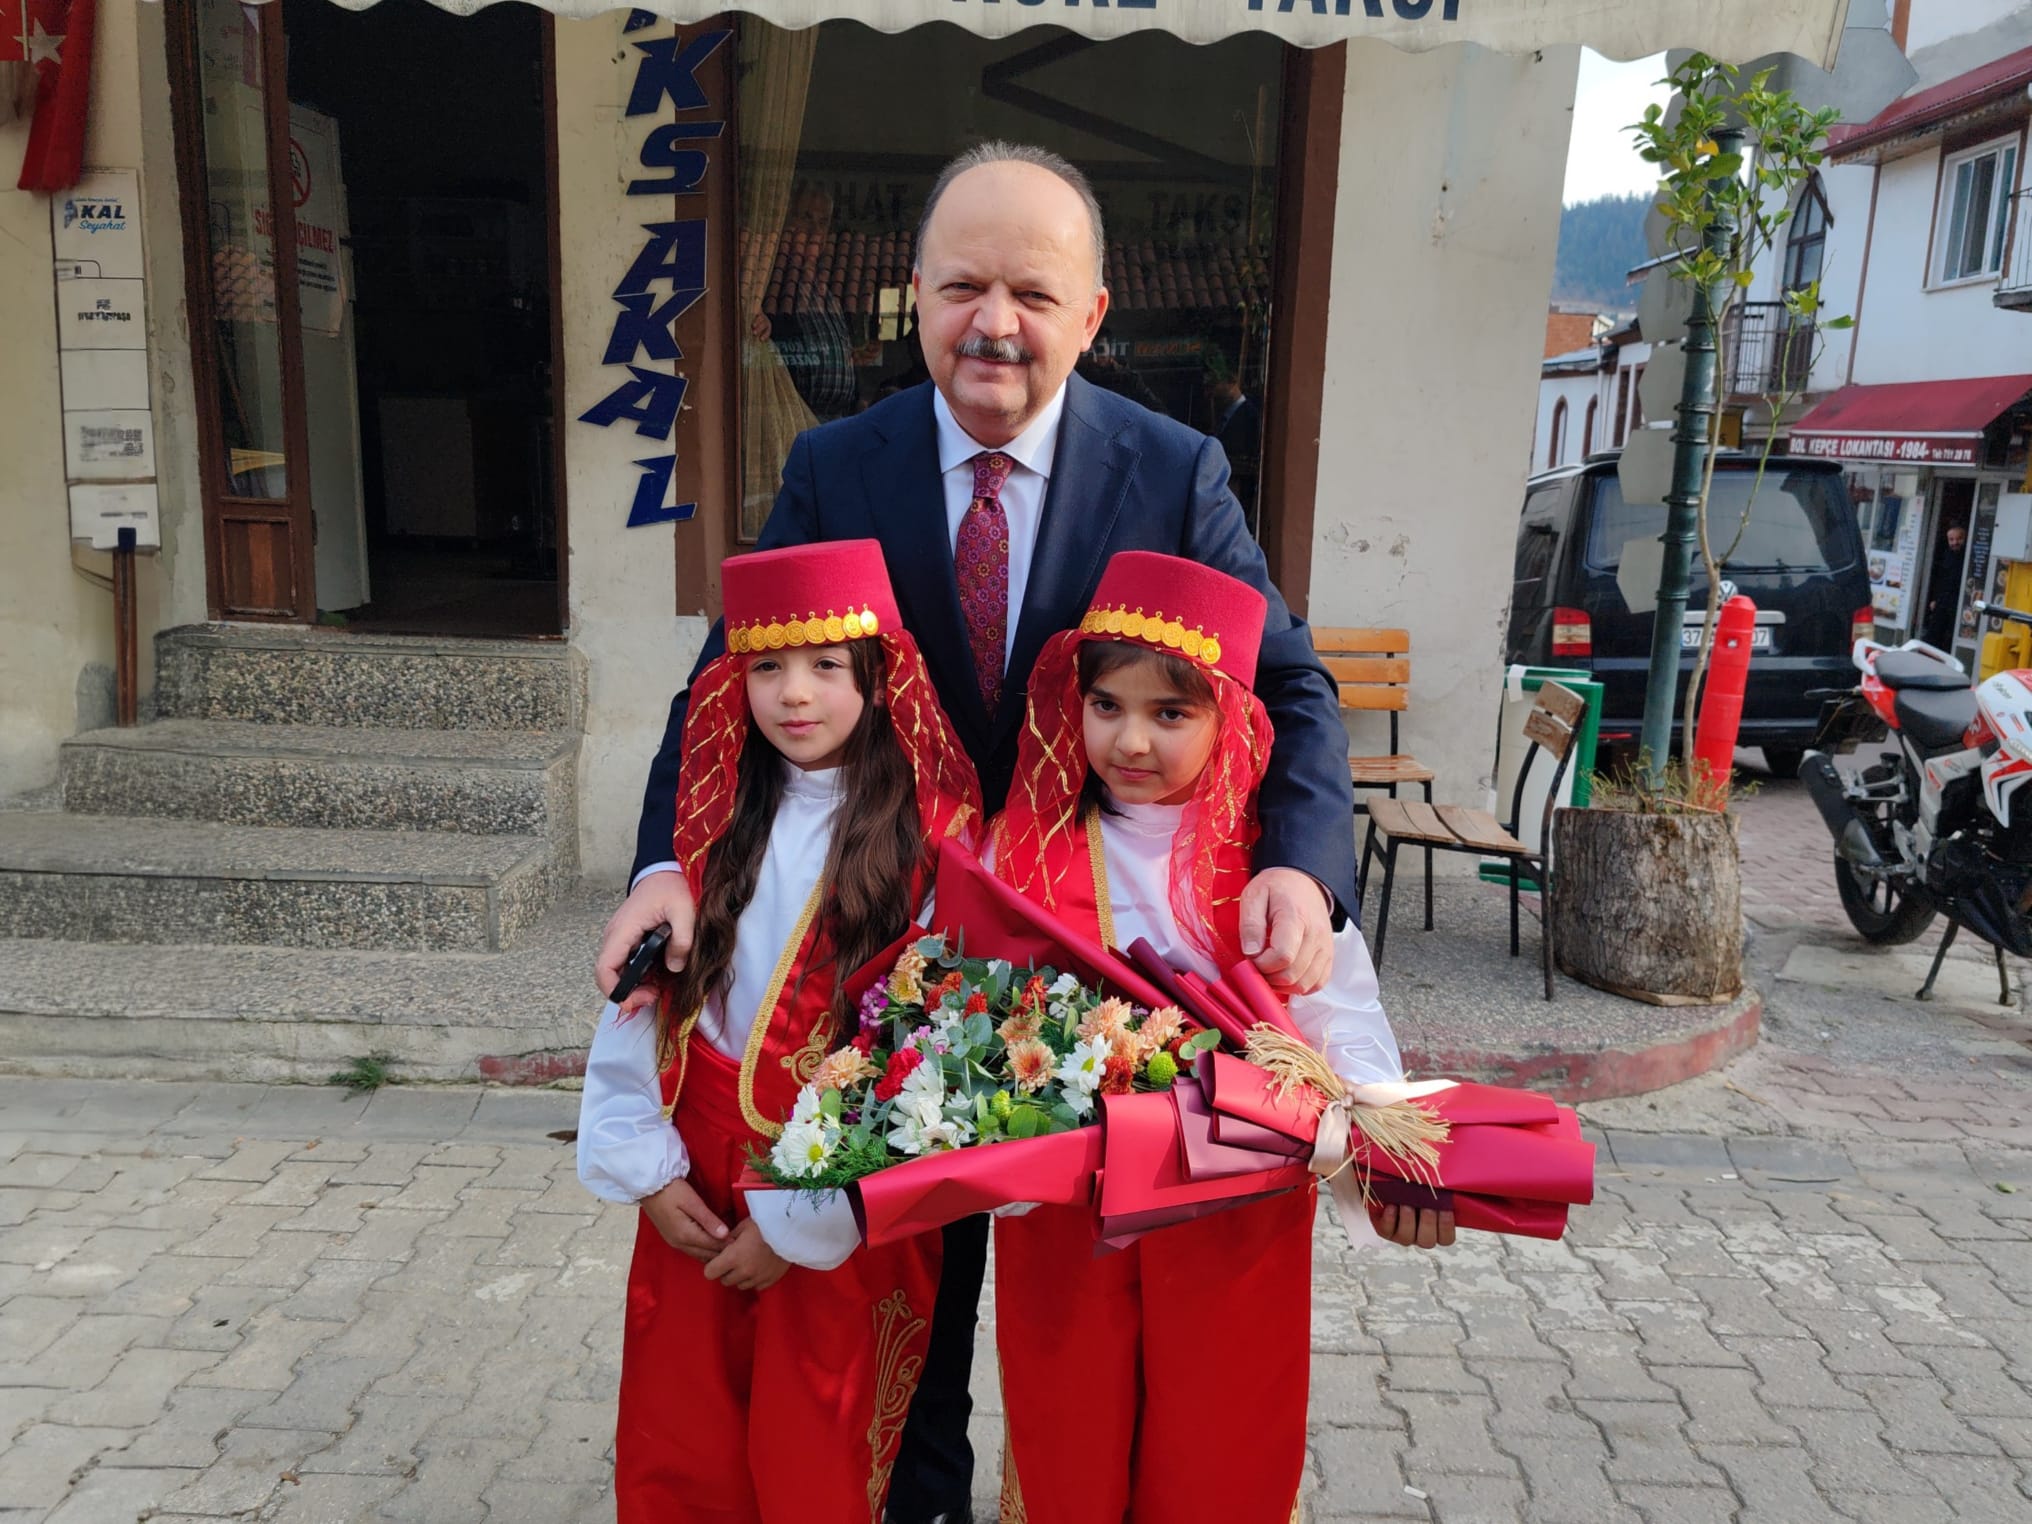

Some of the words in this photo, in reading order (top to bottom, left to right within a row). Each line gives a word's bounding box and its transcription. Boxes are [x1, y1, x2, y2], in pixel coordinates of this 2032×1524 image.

[80, 204, 126, 219] KAL
[577, 8, 735, 528] KSAKAL
[1809, 438, 1838, 456] KEPÇE
